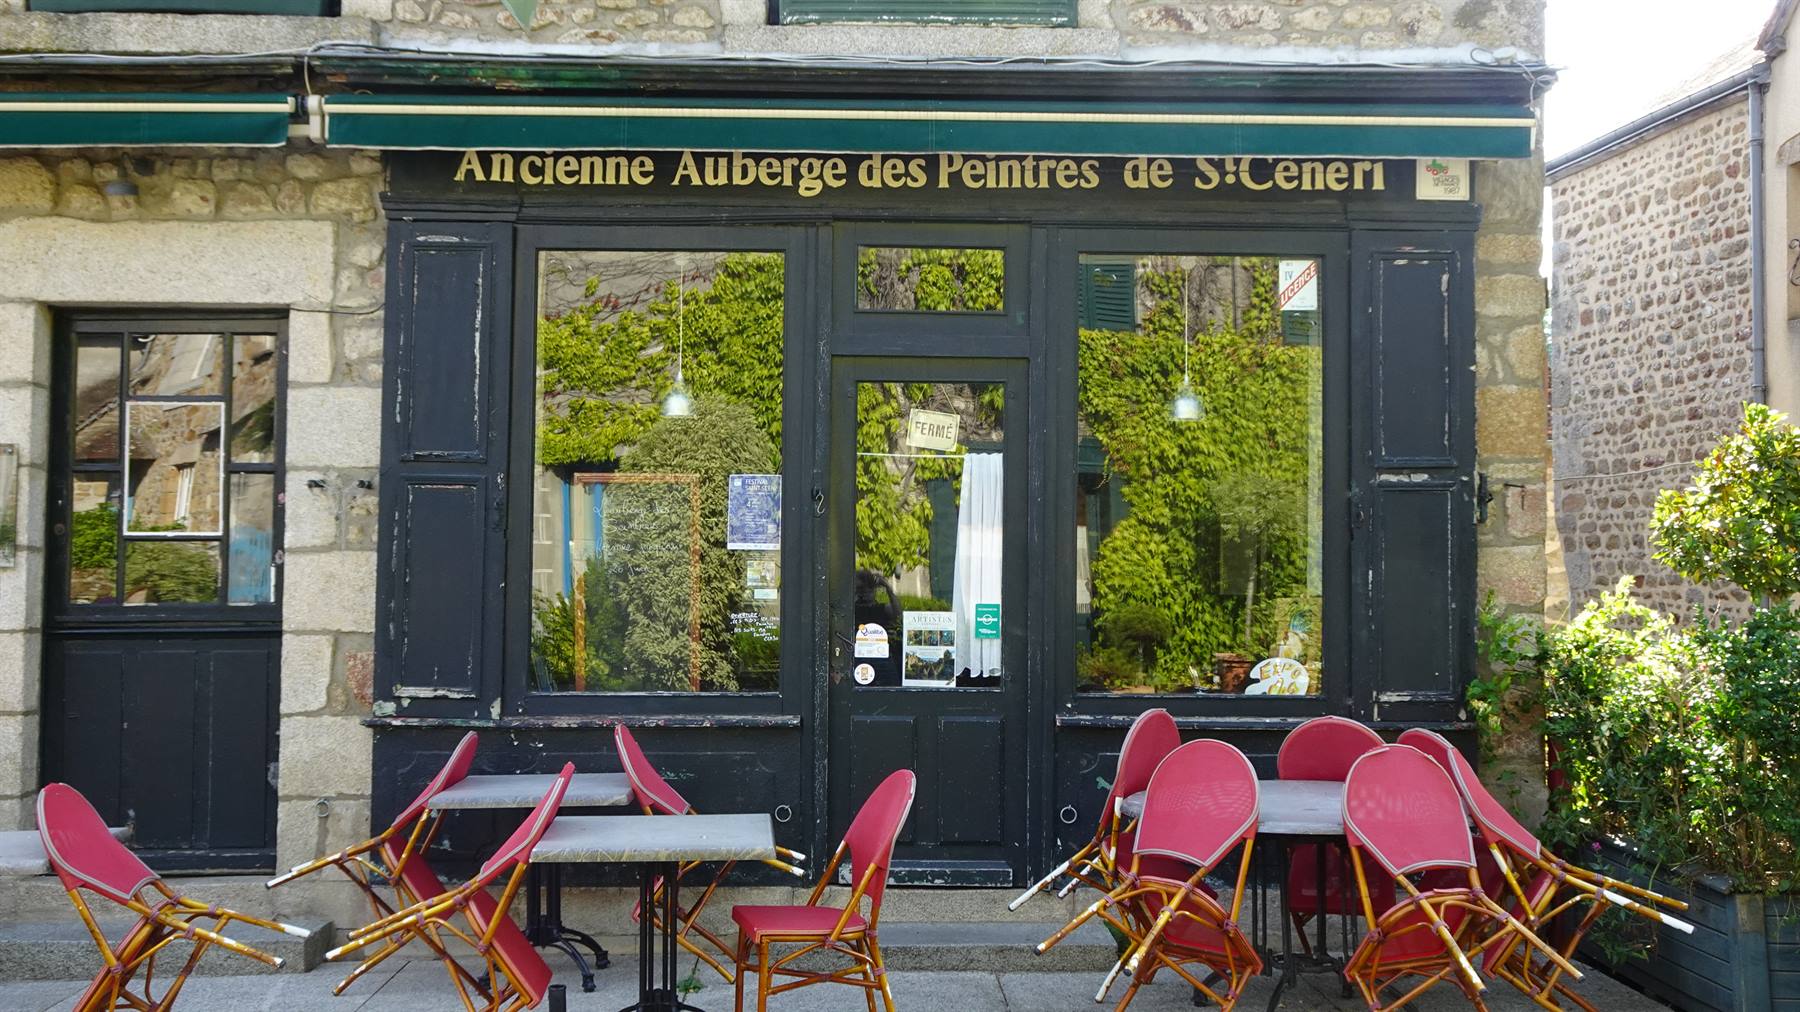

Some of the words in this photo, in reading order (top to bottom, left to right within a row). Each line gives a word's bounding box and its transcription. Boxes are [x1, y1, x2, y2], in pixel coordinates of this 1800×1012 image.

[454, 150, 655, 185] Ancienne
[671, 150, 847, 197] Auberge
[858, 153, 927, 188] des
[937, 153, 1100, 189] Peintres
[1123, 157, 1174, 189] de
[1280, 261, 1318, 307] LICENCE
[1284, 271, 1293, 281] IV
[915, 421, 953, 440] FERMÉ
